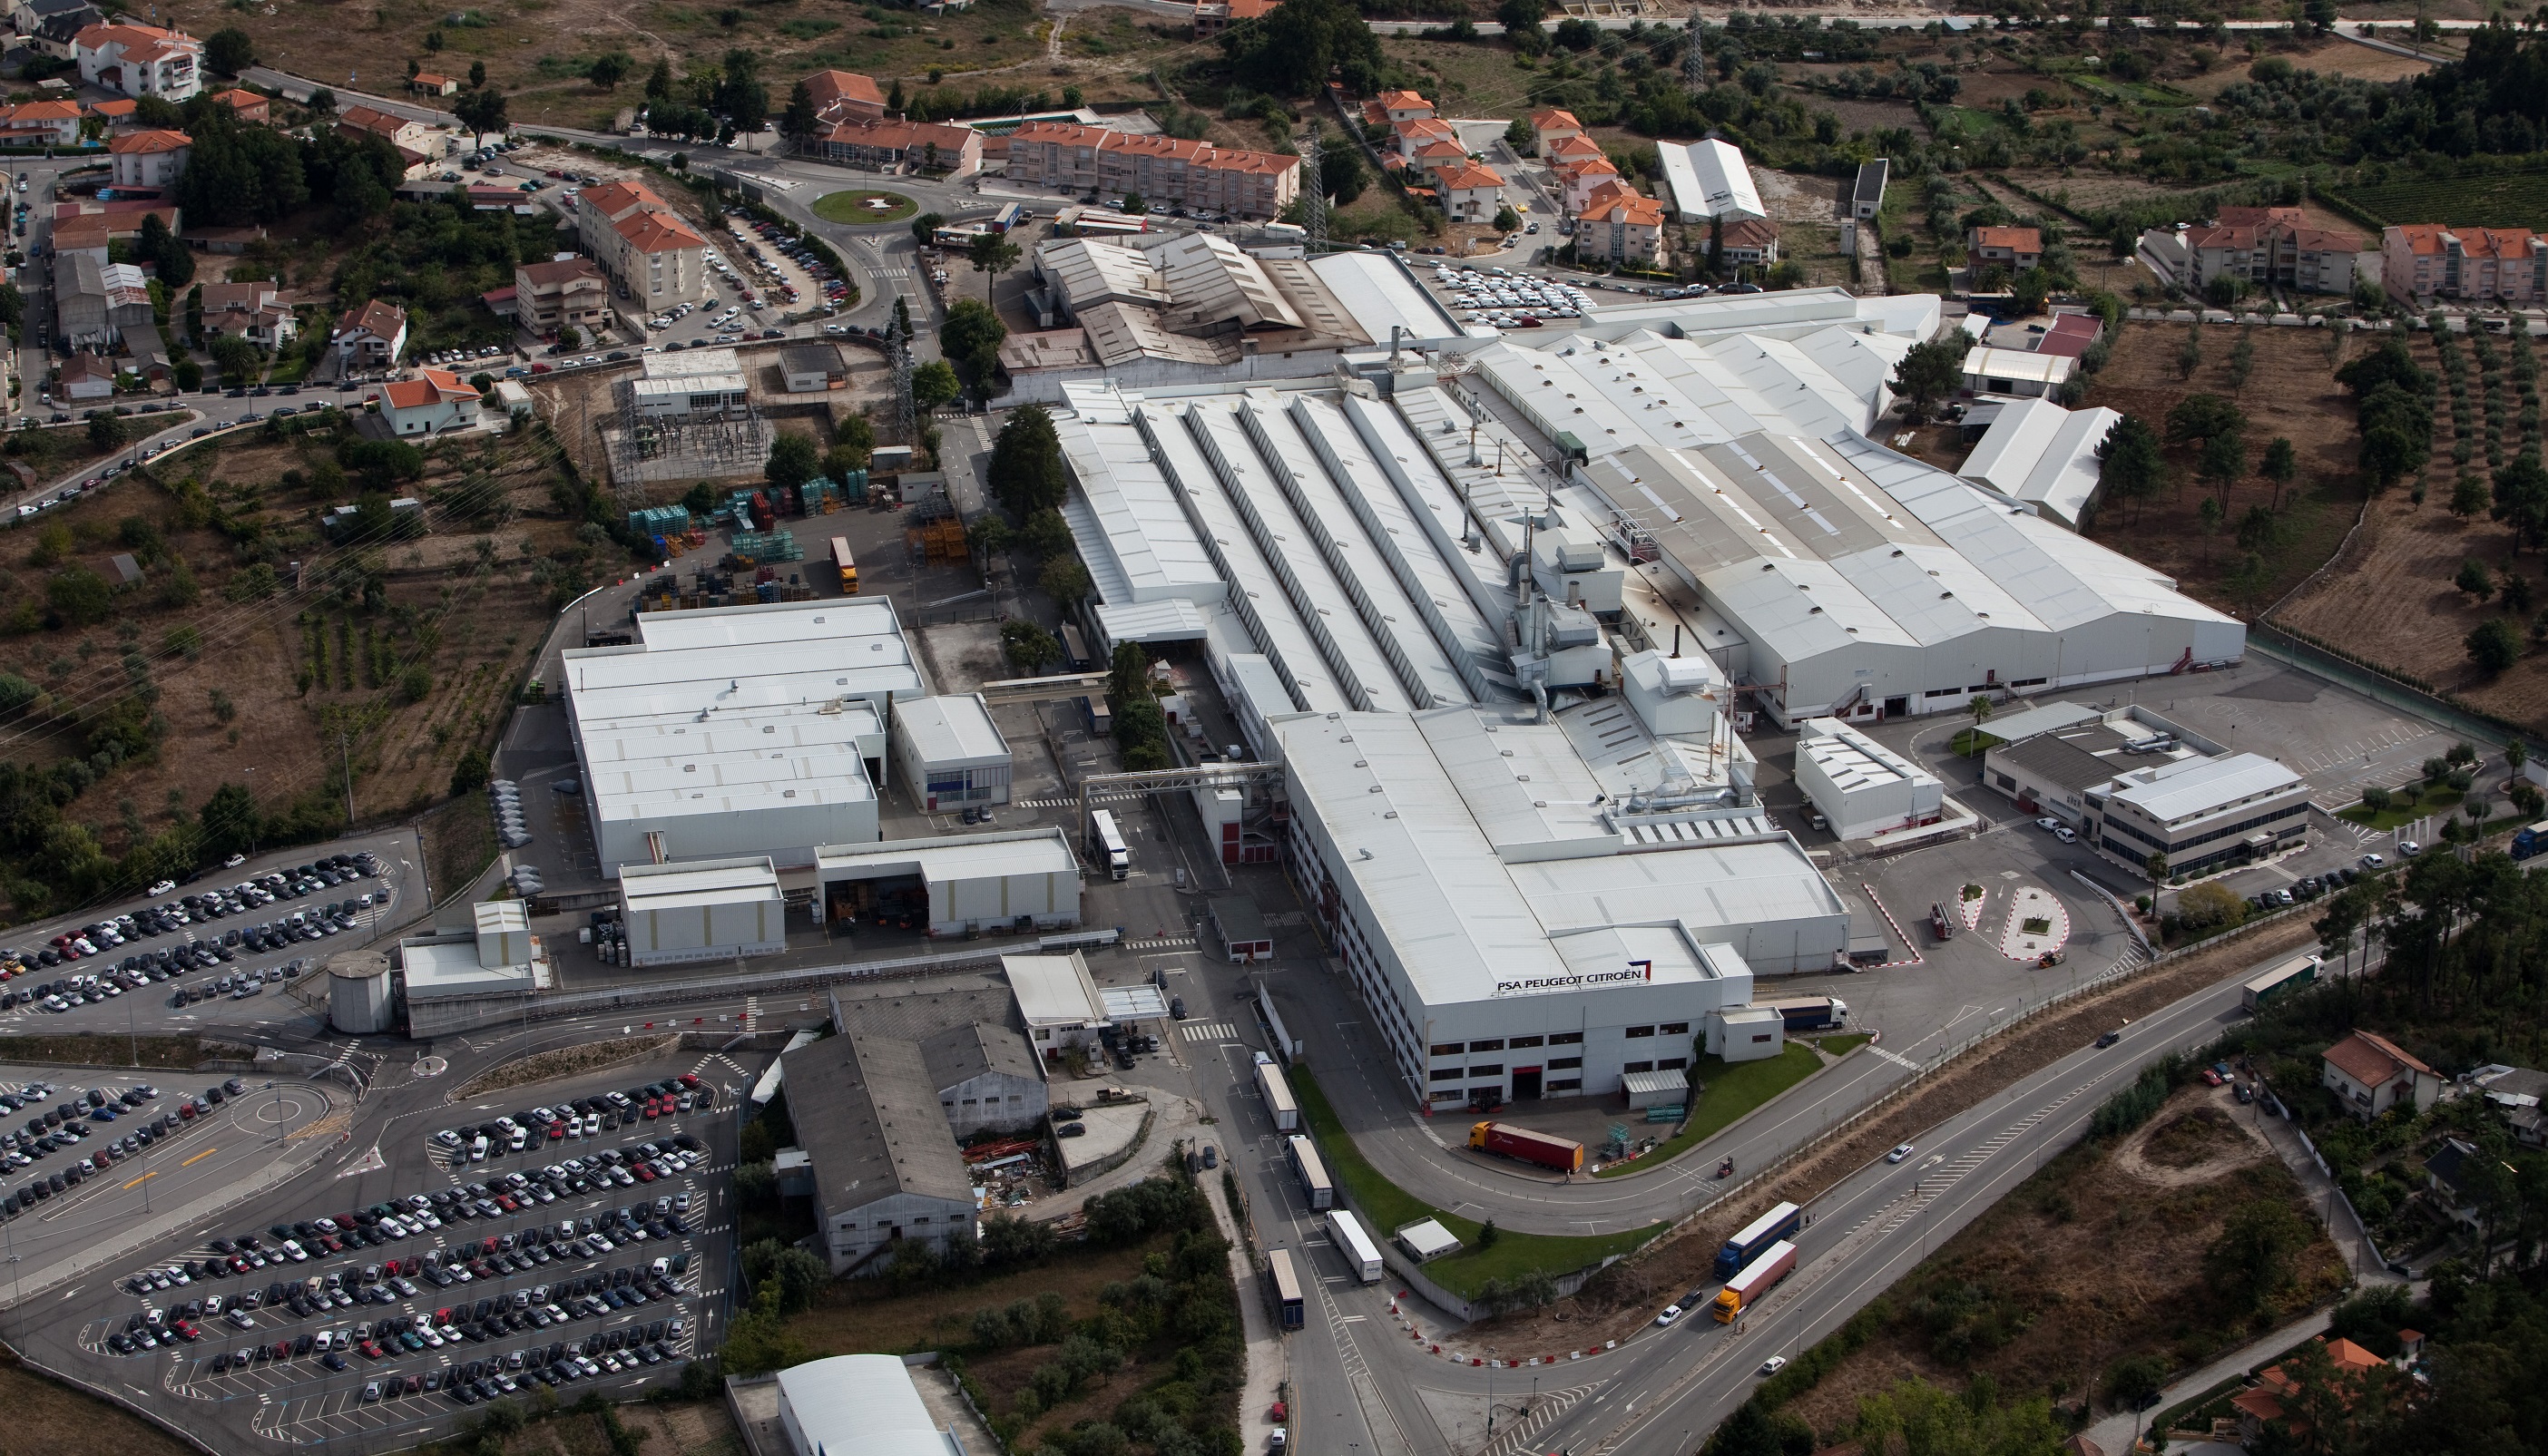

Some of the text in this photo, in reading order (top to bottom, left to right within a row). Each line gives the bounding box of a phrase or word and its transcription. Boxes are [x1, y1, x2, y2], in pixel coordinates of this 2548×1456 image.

[1497, 969, 1642, 991] PSA PEUGEOT CITROËN
